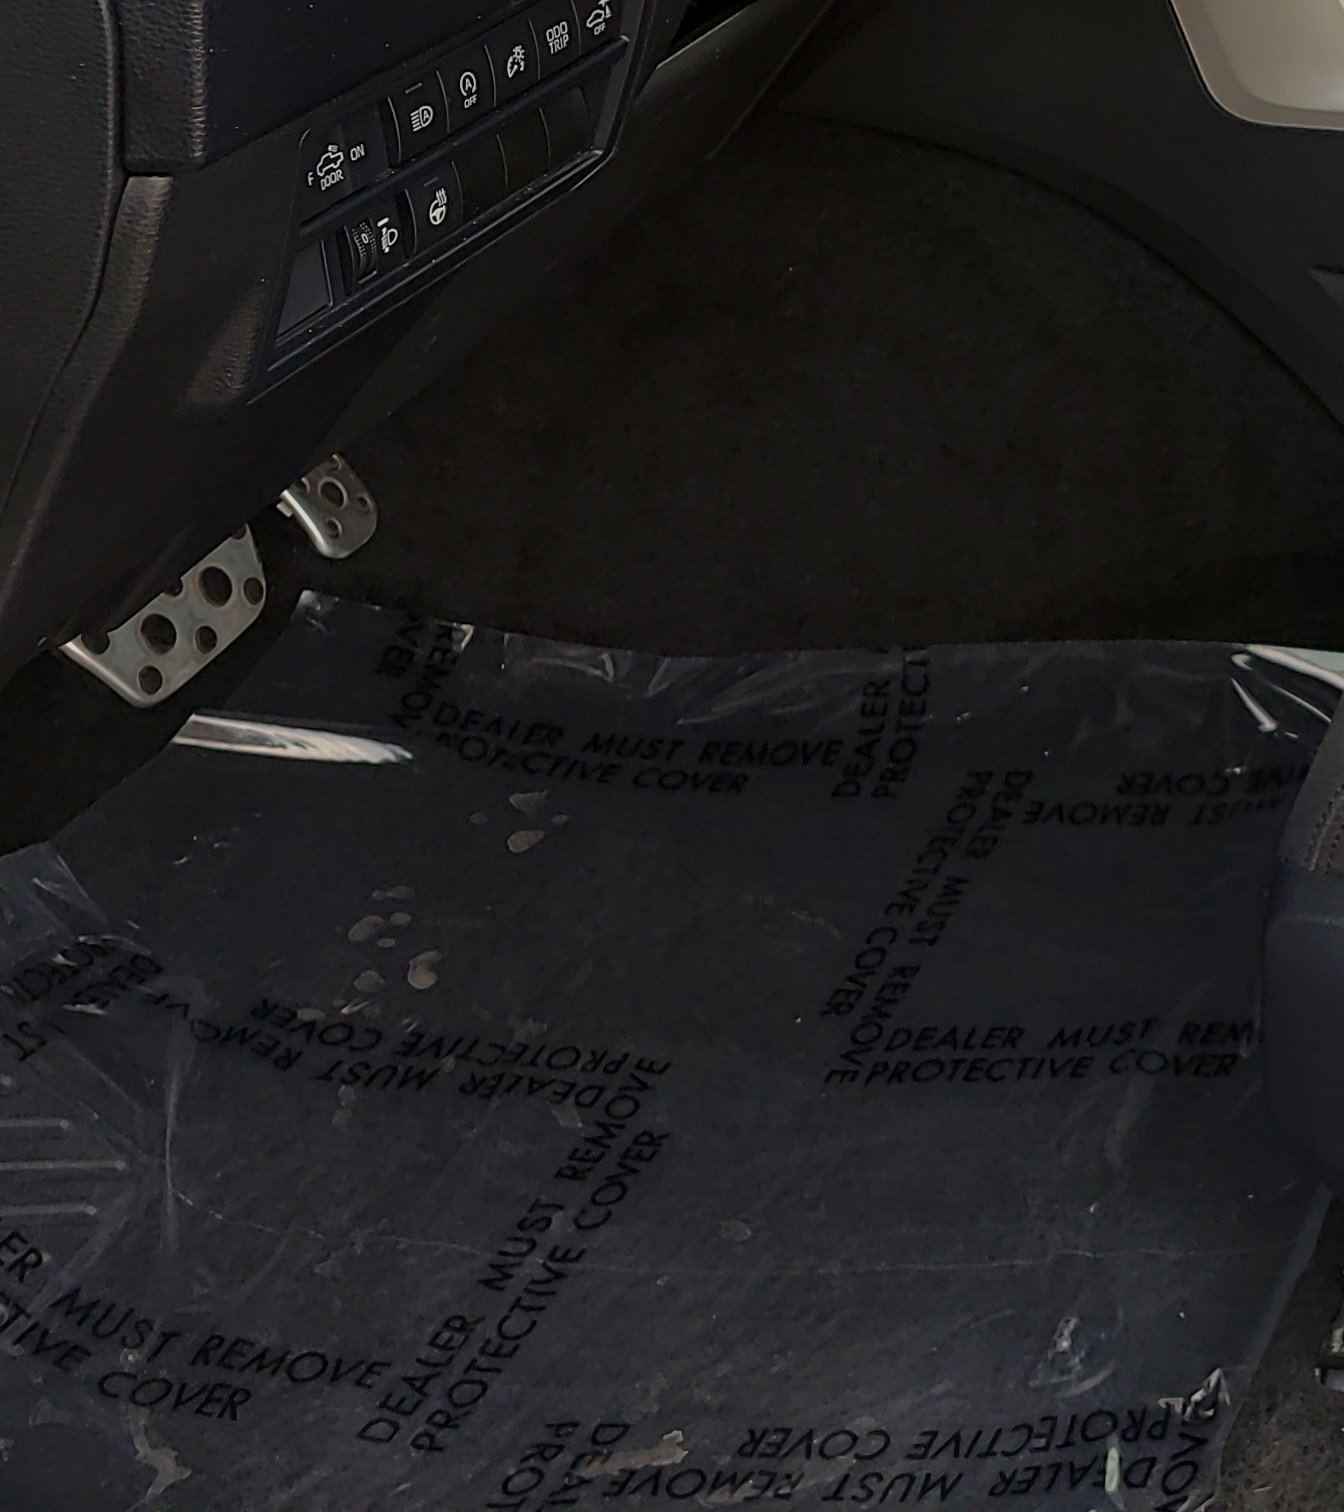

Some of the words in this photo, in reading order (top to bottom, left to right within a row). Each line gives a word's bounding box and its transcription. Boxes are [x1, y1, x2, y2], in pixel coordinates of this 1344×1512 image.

[545, 21, 569, 42] ODO
[548, 34, 570, 55] TRIP
[464, 95, 478, 108] OFF
[350, 144, 365, 161] ON
[320, 169, 344, 191] DOOR
[581, 730, 686, 765] MUST
[701, 736, 845, 770] REMOVE
[631, 764, 752, 795] COVER
[1022, 799, 1171, 828] REMOVE
[248, 997, 381, 1052] COVER
[882, 1024, 1027, 1055] DEALER
[1049, 1016, 1158, 1049] MUST
[400, 1029, 626, 1078] PROTECTIVE
[863, 1053, 1093, 1088] PROTECTIVE
[1106, 1046, 1241, 1080] COVER
[316, 1057, 439, 1094] MUST
[461, 1068, 603, 1110] DEALER
[358, 1313, 485, 1446] DEALER
[476, 1195, 564, 1291] MUST
[555, 1054, 673, 1181] REMOVE
[410, 1243, 589, 1455] PROTECTIVE
[574, 1128, 672, 1231] COVER
[50, 1286, 181, 1363] MUST
[191, 1332, 391, 1390] REMOVE
[97, 1369, 253, 1424] COVER
[736, 1424, 893, 1462] COVER
[907, 1403, 1175, 1460] PROTECTIVE
[822, 1469, 966, 1504] MUST
